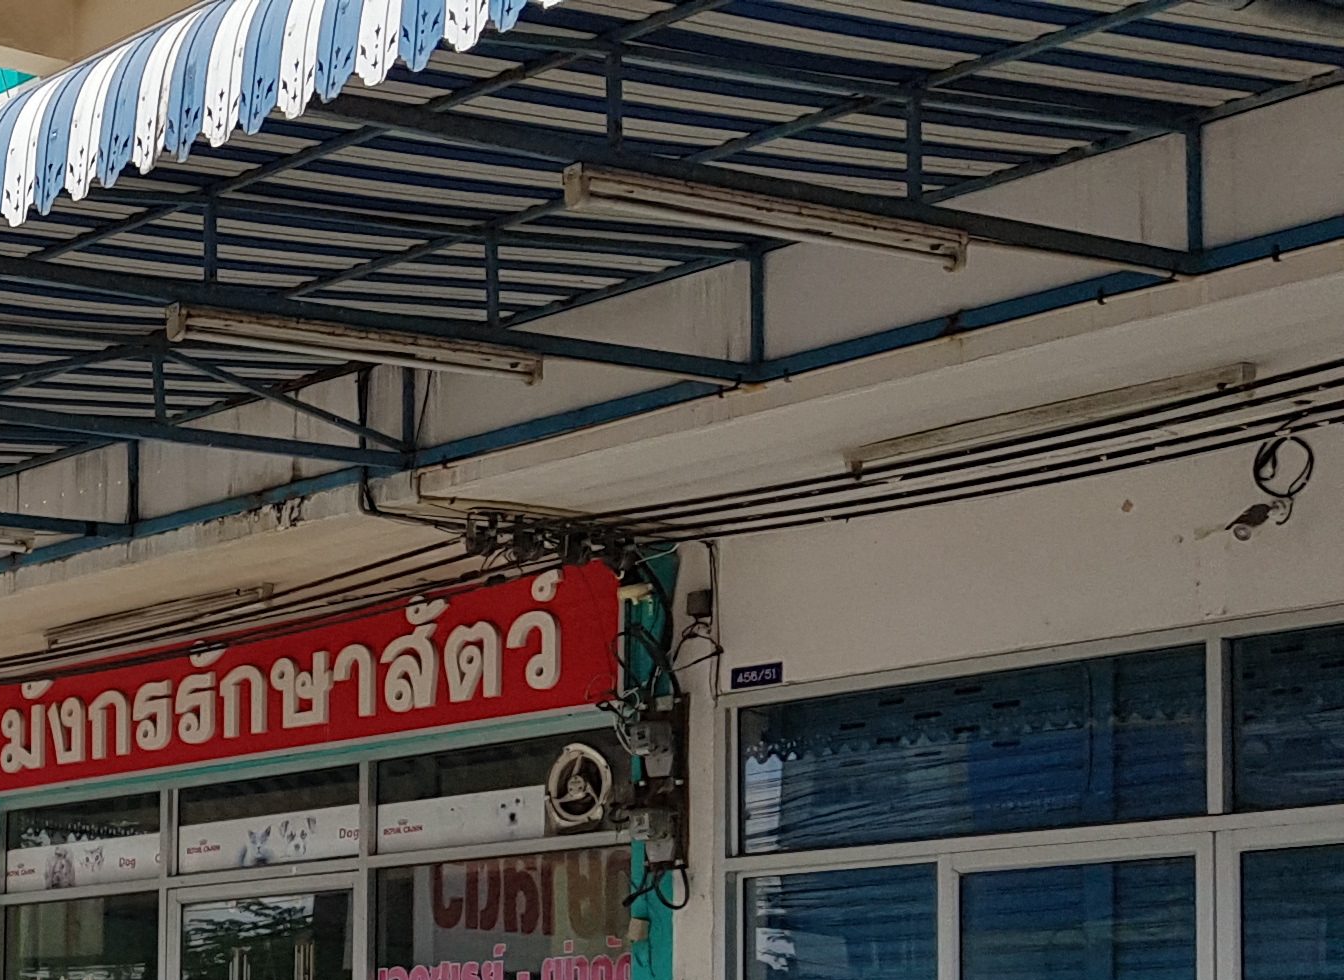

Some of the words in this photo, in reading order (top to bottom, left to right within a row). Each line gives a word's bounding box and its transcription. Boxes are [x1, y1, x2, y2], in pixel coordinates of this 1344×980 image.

[0, 568, 564, 774] มังกรรักษาสัตว์
[339, 828, 360, 840] Dog
[118, 857, 136, 869] Dog
